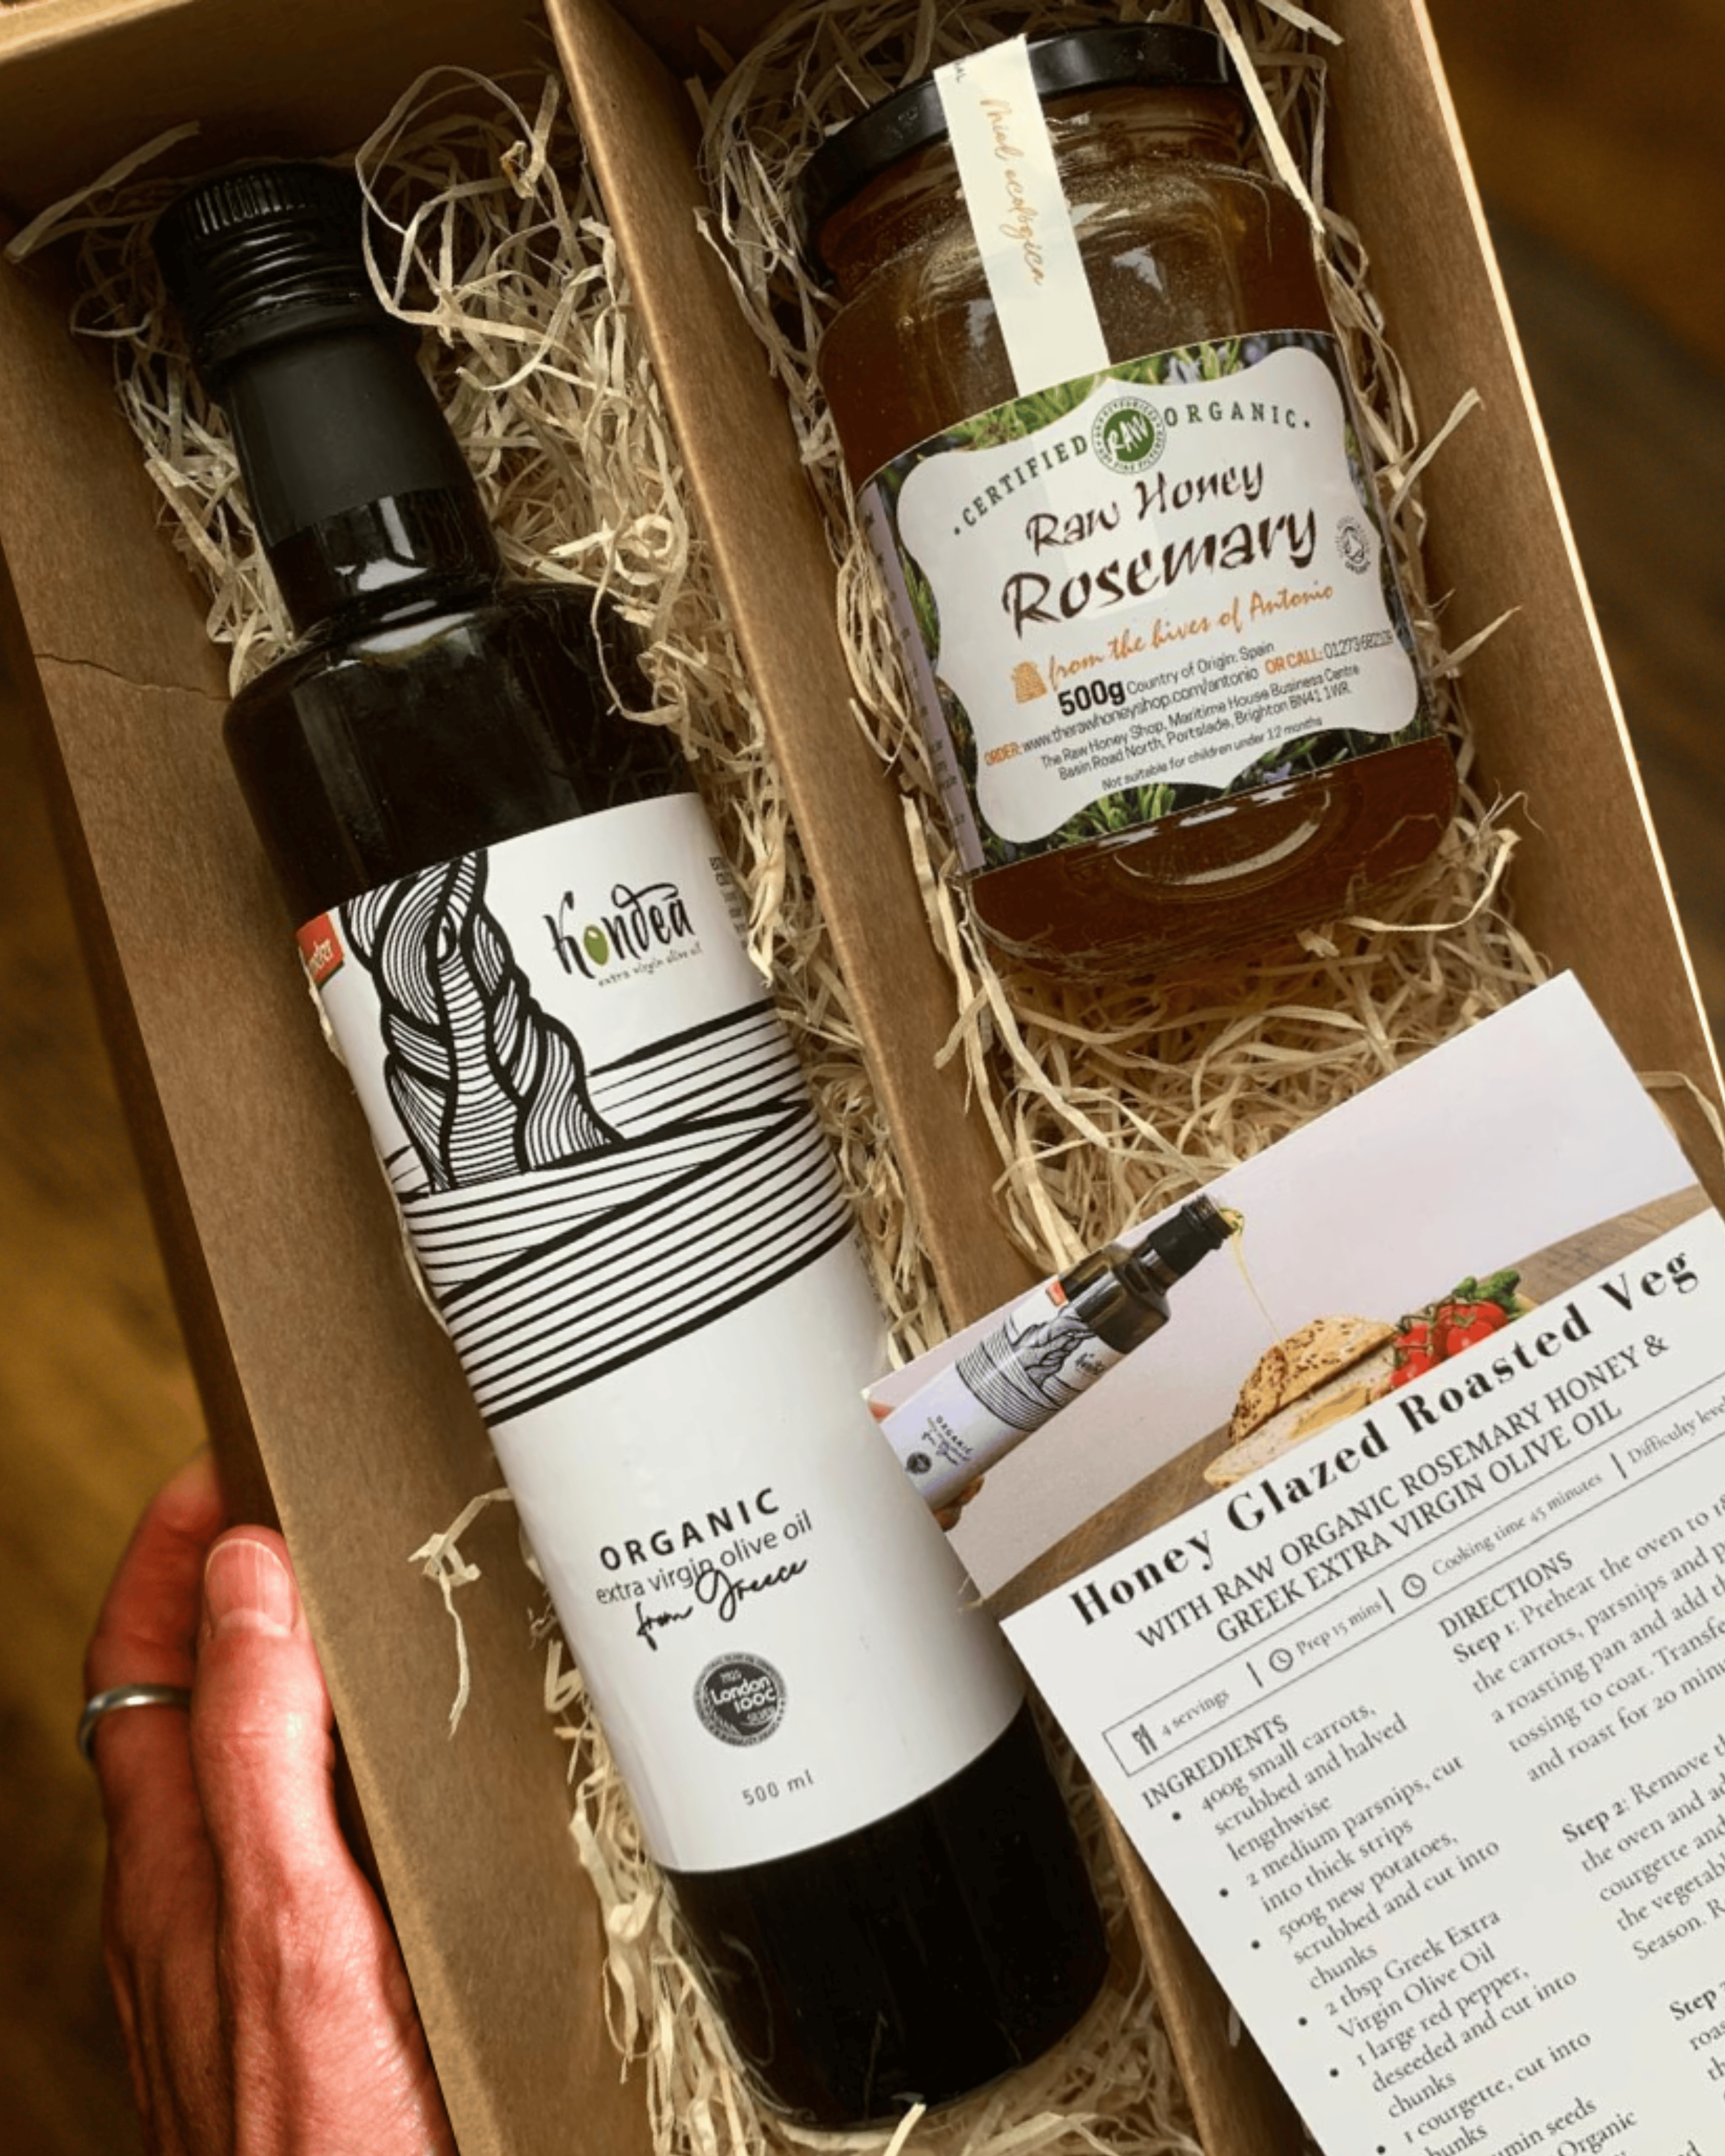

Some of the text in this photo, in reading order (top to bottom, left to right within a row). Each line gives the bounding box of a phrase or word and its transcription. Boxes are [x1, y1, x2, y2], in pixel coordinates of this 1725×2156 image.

[963, 402, 1298, 527] CERTIFIED ORGANIC
[1025, 461, 1263, 556] Raw Honey
[1002, 508, 1317, 639] Rosemary
[1047, 581, 1333, 691] from the hives of Antonio
[1057, 680, 1126, 716] 500g
[1126, 670, 1179, 694] Country
[1182, 664, 1195, 678] of
[1239, 642, 1275, 661] Spain
[1041, 754, 1062, 769] The
[1062, 747, 1088, 762] Raw
[1089, 733, 1128, 753] Honey
[1167, 701, 1226, 727] Maritime
[1227, 689, 1270, 710] House
[1270, 672, 1324, 696] Business
[1324, 664, 1360, 682] Centre
[1057, 760, 1092, 780] Basin
[1092, 749, 1123, 768] Road
[1234, 699, 1289, 727] Brighton
[1102, 778, 1122, 791] Not
[1124, 761, 1167, 784] suitable
[1169, 756, 1186, 770] for
[1187, 742, 1233, 764] children
[1233, 732, 1264, 751] under
[1069, 1253, 1697, 1626] Honey Glazed Roasted Veg
[1627, 1419, 1696, 1464] Difficulty
[600, 1487, 779, 1571] ORGANIC
[1136, 1335, 1668, 1647] WITH RAW ORGANIC ROSEMARY HONEY &
[1216, 1398, 1622, 1642] GREEK EXTRA VIRGIN OLIVE OIL
[1432, 1474, 1603, 1576] Cooking time minutes
[596, 1509, 813, 1605] extra virgin olive oil
[1437, 1551, 1573, 1638] DIRECTIONS
[1453, 1512, 1710, 1663] Step Preheat the oven to
[634, 1559, 808, 1652] from Greece
[1296, 1599, 1382, 1656] Prep mins
[1473, 1545, 1710, 1694] the carrots, parsnips and
[1506, 1585, 1709, 1714] roasting pan and add
[710, 1676, 771, 1705] London
[1172, 1689, 1230, 1728] servings
[1508, 1706, 1581, 1753] tossing
[1579, 1693, 1603, 1712] to
[1606, 1666, 1653, 1698] coat.
[742, 1769, 814, 1806] 500 ml
[1141, 1714, 1289, 1810] INGREDIENTS
[1202, 1705, 1377, 1812] 400g small carrots,
[1215, 1711, 1408, 1837] scrubbed and halved
[1527, 1704, 1649, 1782] and roast for
[1226, 1797, 1332, 1862] lengthwise
[1246, 1756, 1464, 1887] 2 medium parsnips, cut
[1562, 1811, 1610, 1843] Step
[1629, 1752, 1710, 1805] Remove
[1581, 1789, 1706, 1872] the oven and
[1260, 1820, 1413, 1914] into thick strips
[1278, 1834, 1458, 1944] 500g new potatoes,
[1293, 1842, 1499, 1964] scrubbed and cut into
[1600, 1844, 1689, 1902] courgette
[1325, 1911, 1501, 2016] 2 tbsp Greek Extra
[1617, 1906, 1649, 1931] the
[1632, 1917, 1707, 1960] Season.
[1309, 1944, 1378, 1989] chunks
[1337, 1941, 1496, 2038] Virgin Olive Oil
[1365, 1967, 1530, 2060] large red pepper,
[1372, 1972, 1576, 2093] deseeded and cut into
[1388, 2073, 1456, 2118] chunks
[1417, 2033, 1591, 2136] courgette, cut into
[1546, 2096, 1597, 2136] seeds
